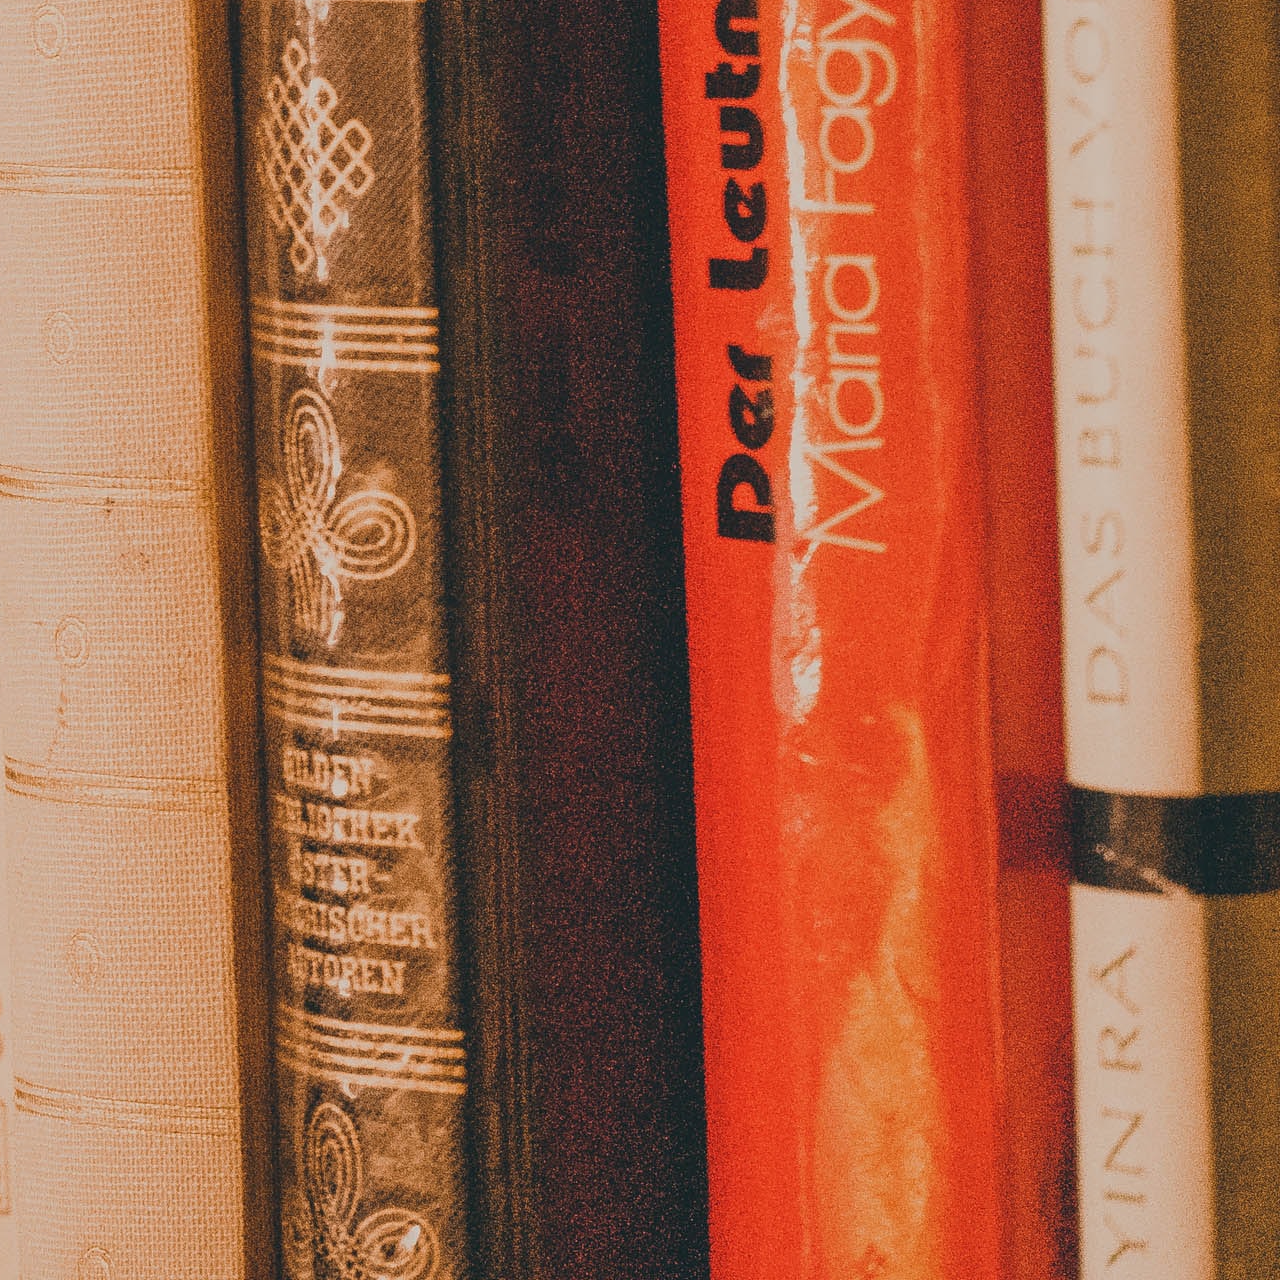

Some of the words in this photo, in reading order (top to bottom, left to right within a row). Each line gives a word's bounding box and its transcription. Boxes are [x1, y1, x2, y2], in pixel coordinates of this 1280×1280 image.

[802, 254, 887, 554] Maria
[1068, 199, 1126, 469] BUCH
[716, 343, 776, 544] Der
[1081, 508, 1131, 707] DAS
[1100, 1107, 1149, 1268] YIN
